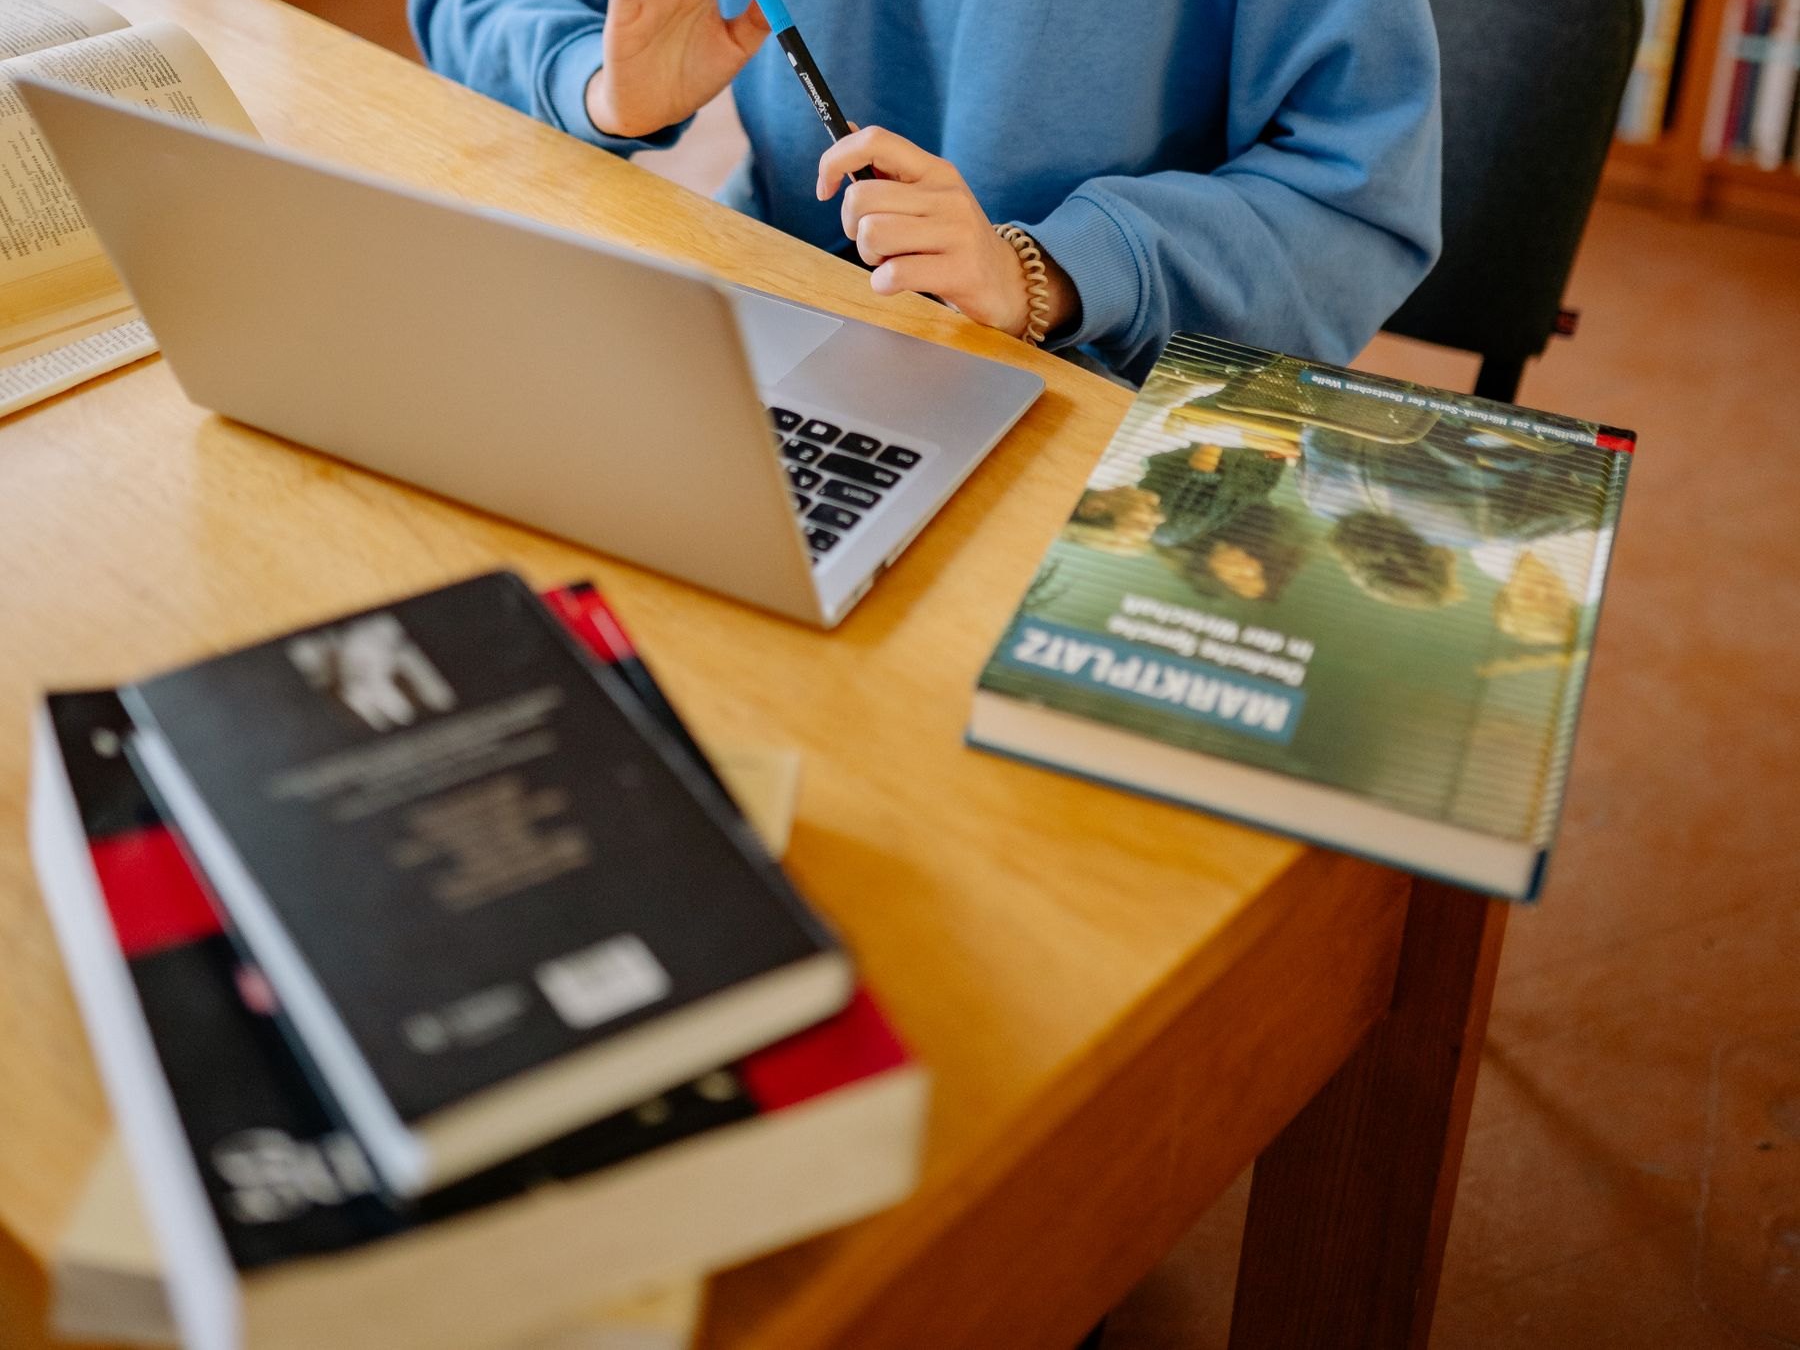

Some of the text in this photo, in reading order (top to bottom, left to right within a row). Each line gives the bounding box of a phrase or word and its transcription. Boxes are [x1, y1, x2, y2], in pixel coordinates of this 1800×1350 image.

[1311, 374, 1342, 389] Welle
[1345, 383, 1404, 402] Deutschen
[1407, 395, 1426, 407] der
[1121, 593, 1240, 643] Wirtschaft
[1241, 626, 1285, 652] der
[1200, 639, 1306, 687] Deutsche
[1013, 627, 1291, 733] MARKTPLATZ
